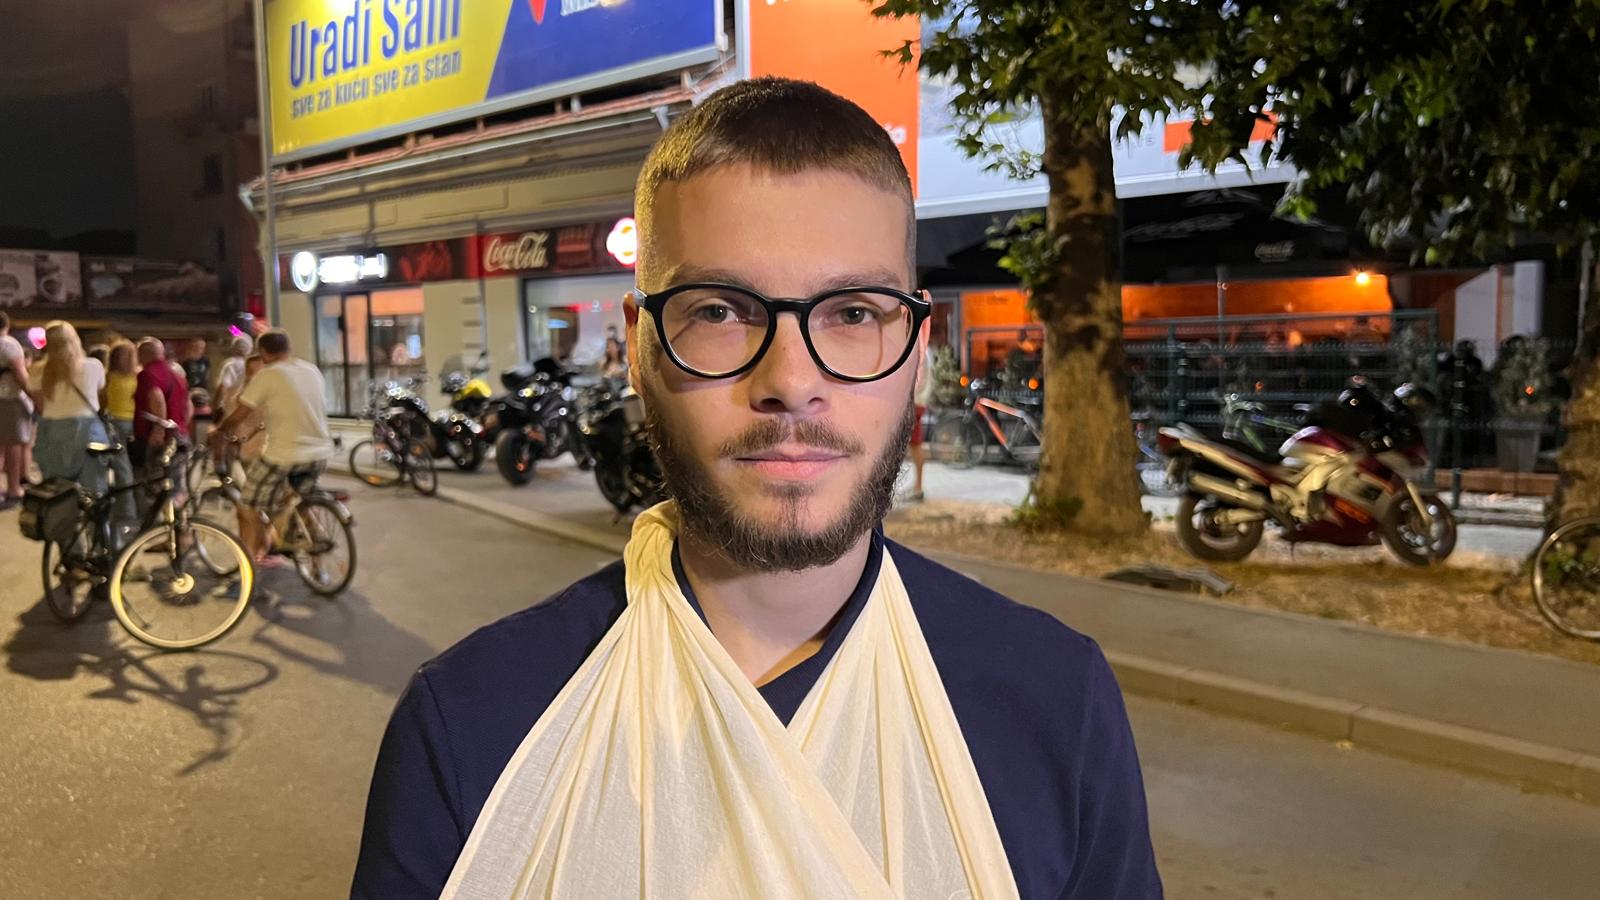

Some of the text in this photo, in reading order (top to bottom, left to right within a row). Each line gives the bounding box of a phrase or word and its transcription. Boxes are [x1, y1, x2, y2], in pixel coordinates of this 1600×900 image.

[290, 0, 371, 88] Uradi
[292, 93, 314, 118] sve
[317, 88, 331, 111] za
[374, 69, 399, 96] sve
[403, 63, 419, 87] za
[425, 50, 461, 82] stan
